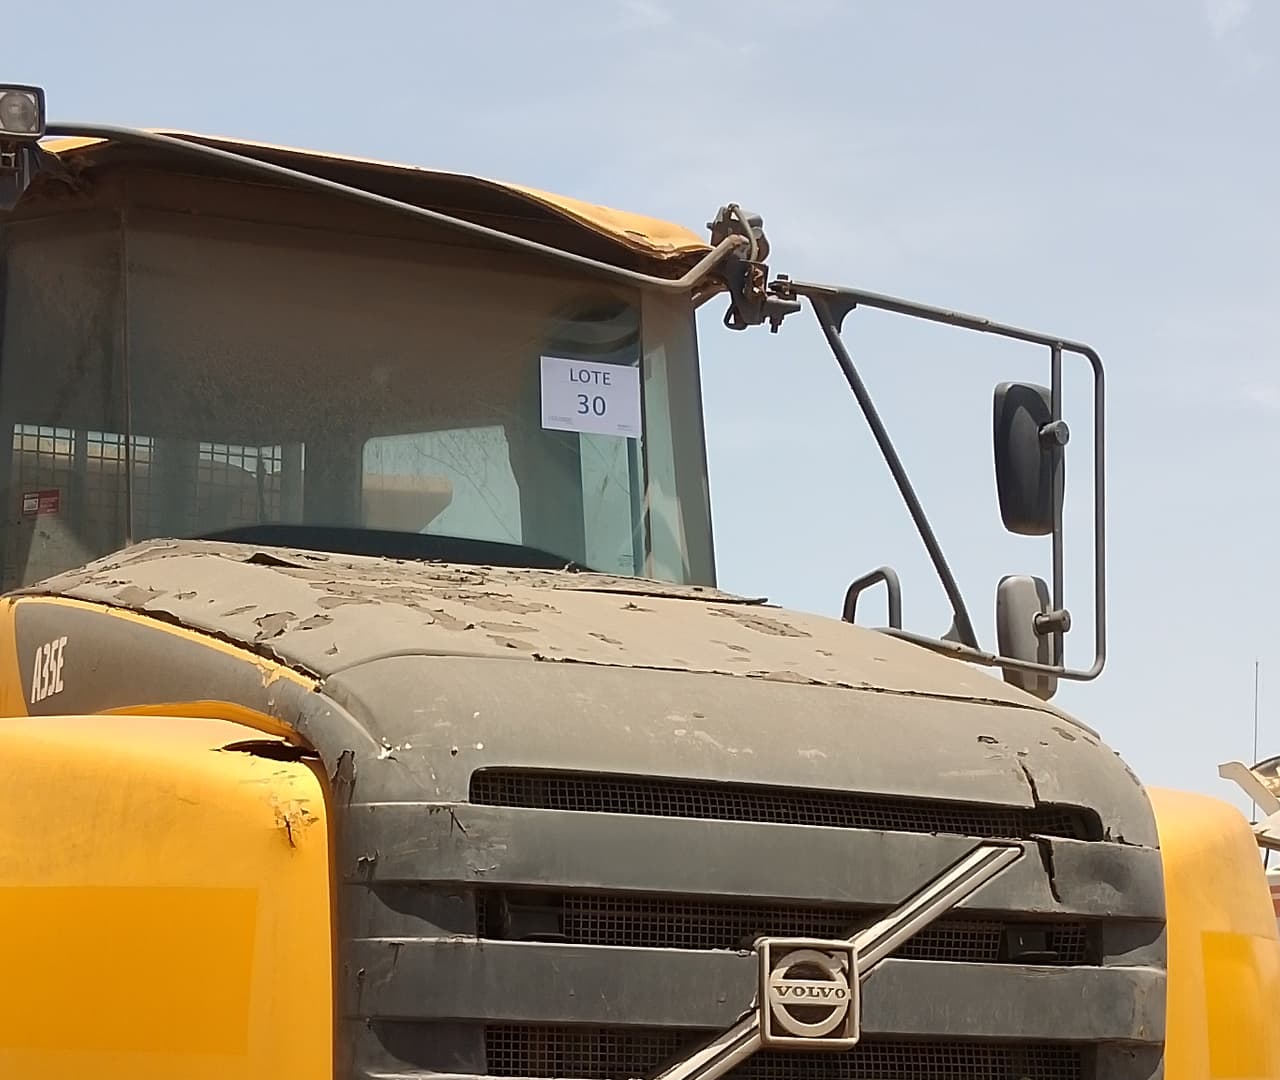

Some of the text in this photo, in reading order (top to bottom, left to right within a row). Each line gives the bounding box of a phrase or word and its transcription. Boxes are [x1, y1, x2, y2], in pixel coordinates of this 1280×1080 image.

[569, 367, 612, 386] LOTE
[577, 393, 606, 416] 30
[31, 636, 68, 704] A35E
[772, 985, 846, 999] VOLVO
